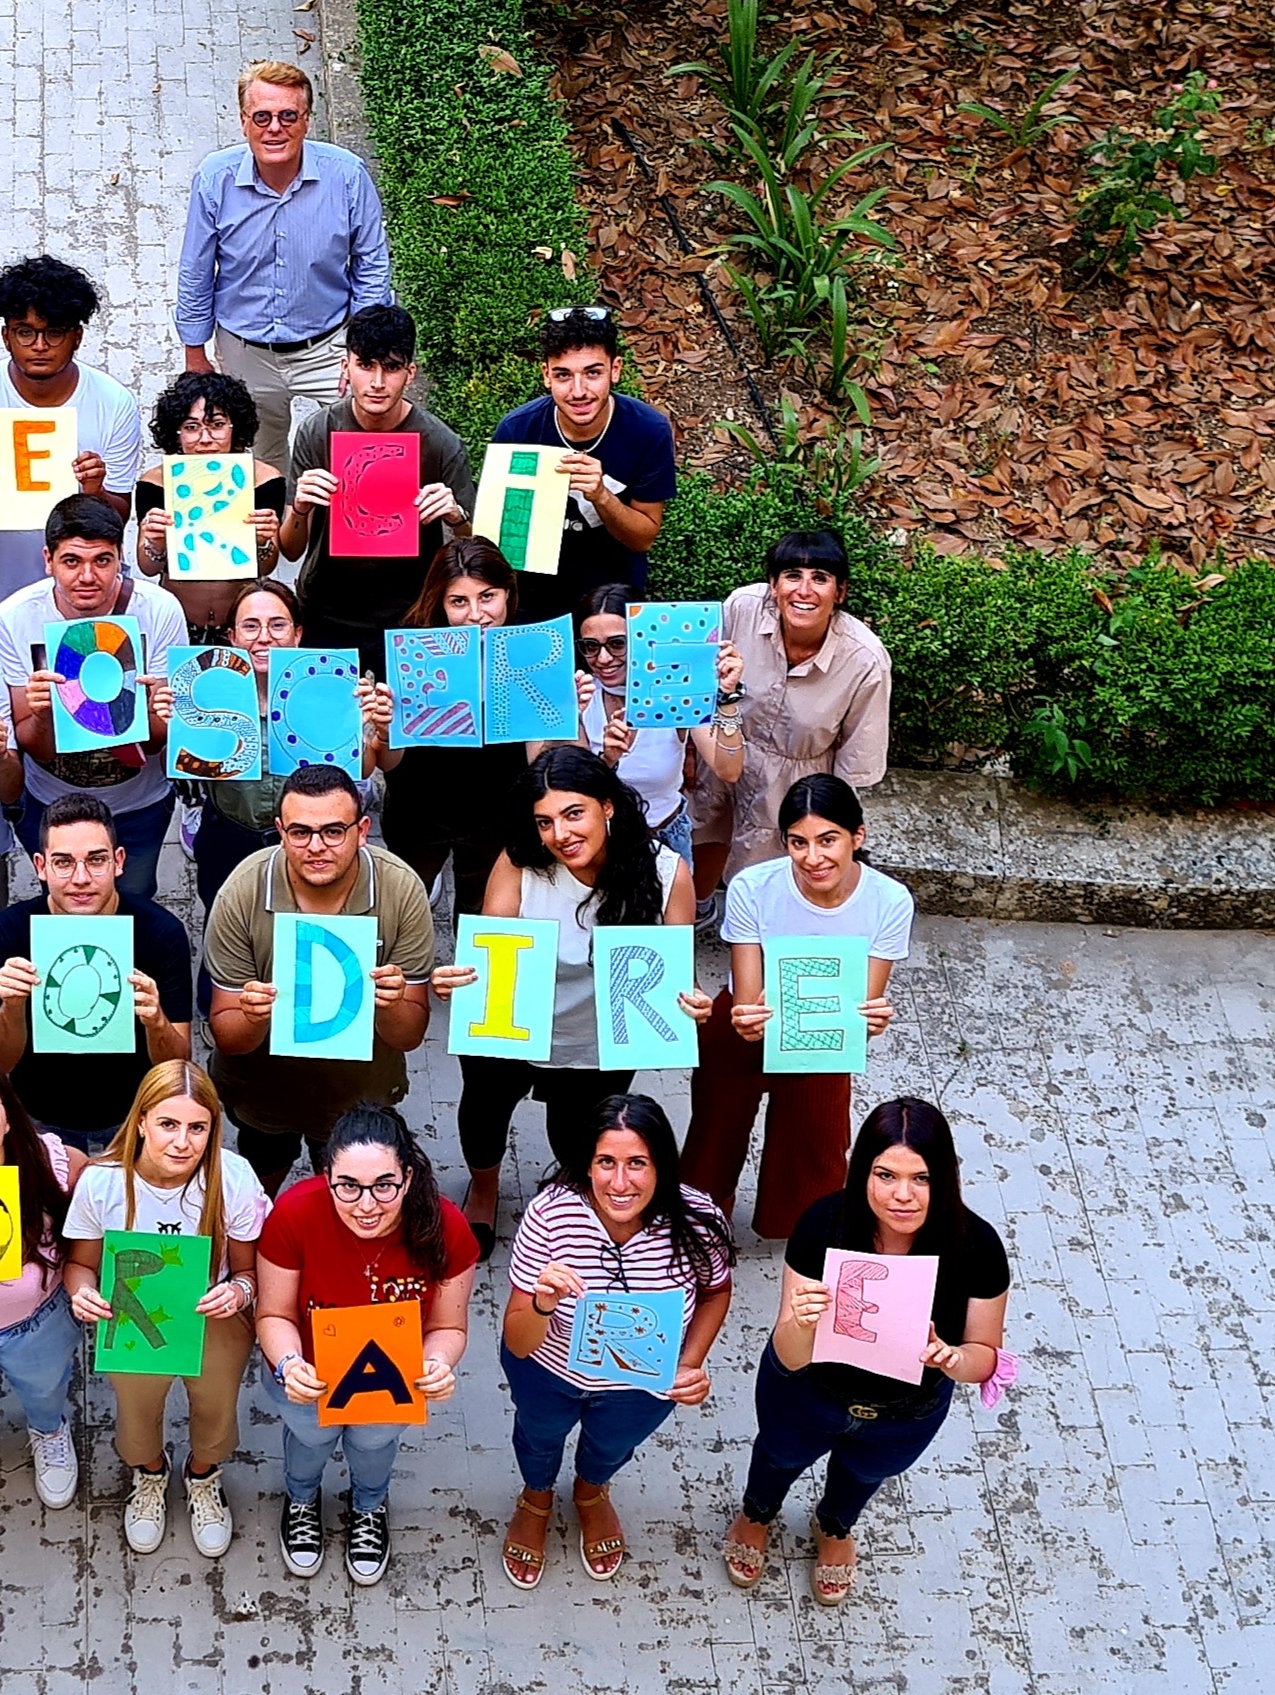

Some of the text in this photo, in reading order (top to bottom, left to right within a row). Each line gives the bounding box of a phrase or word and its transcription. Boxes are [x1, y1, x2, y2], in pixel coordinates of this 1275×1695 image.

[13, 420, 56, 491] E
[342, 444, 405, 536] C
[171, 459, 251, 572] R
[54, 621, 136, 736] O
[171, 648, 261, 780] S
[271, 654, 359, 768] C
[393, 631, 476, 737] E
[489, 625, 565, 736] R
[628, 604, 719, 727] E
[43, 944, 121, 1038] O
[294, 920, 364, 1043] D
[469, 932, 534, 1041] I
[610, 945, 678, 1045] R
[780, 958, 844, 1051] E
[103, 1249, 167, 1349] R
[578, 1299, 661, 1378] R
[833, 1260, 889, 1343] E
[326, 1339, 413, 1409] A
